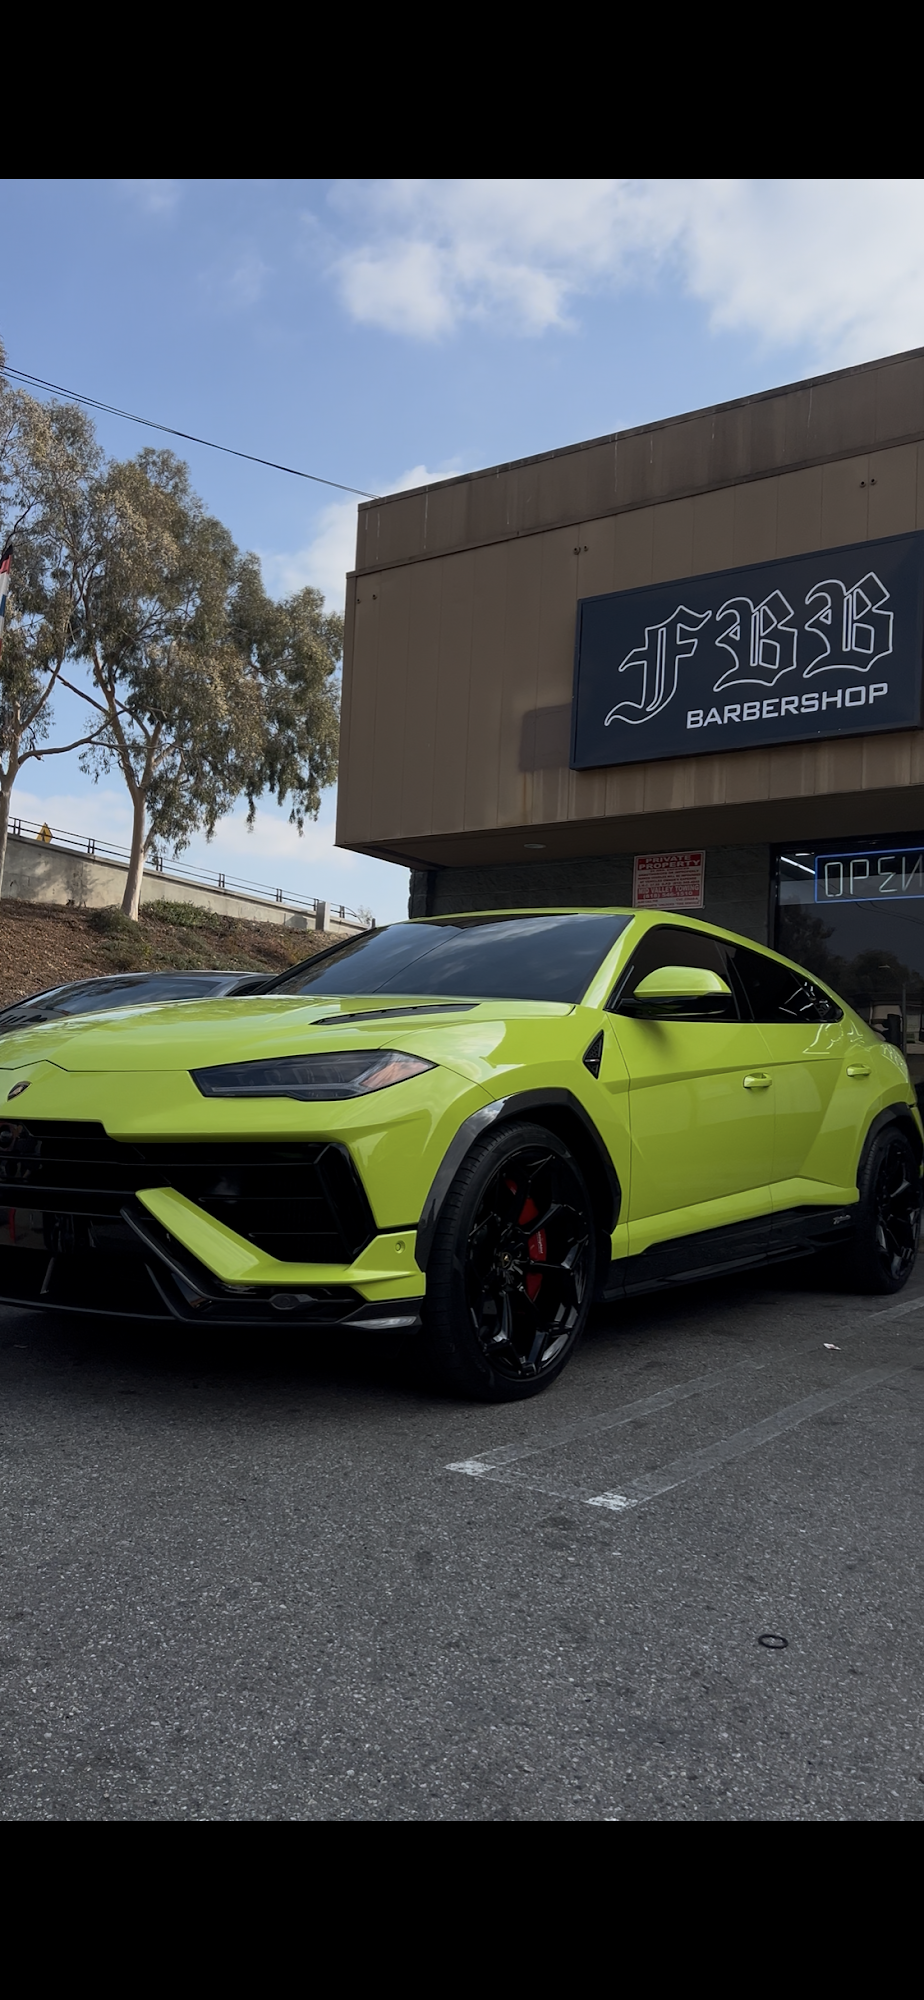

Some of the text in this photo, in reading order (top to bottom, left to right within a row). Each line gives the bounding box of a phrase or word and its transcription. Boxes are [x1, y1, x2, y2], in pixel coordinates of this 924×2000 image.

[604, 571, 894, 726] FBB
[686, 682, 889, 730] BARBERSHOP
[638, 860, 701, 870] PROPERTY
[645, 855, 691, 864] PRIVATE
[650, 885, 674, 894] VALLEY
[824, 854, 924, 898] OPEN
